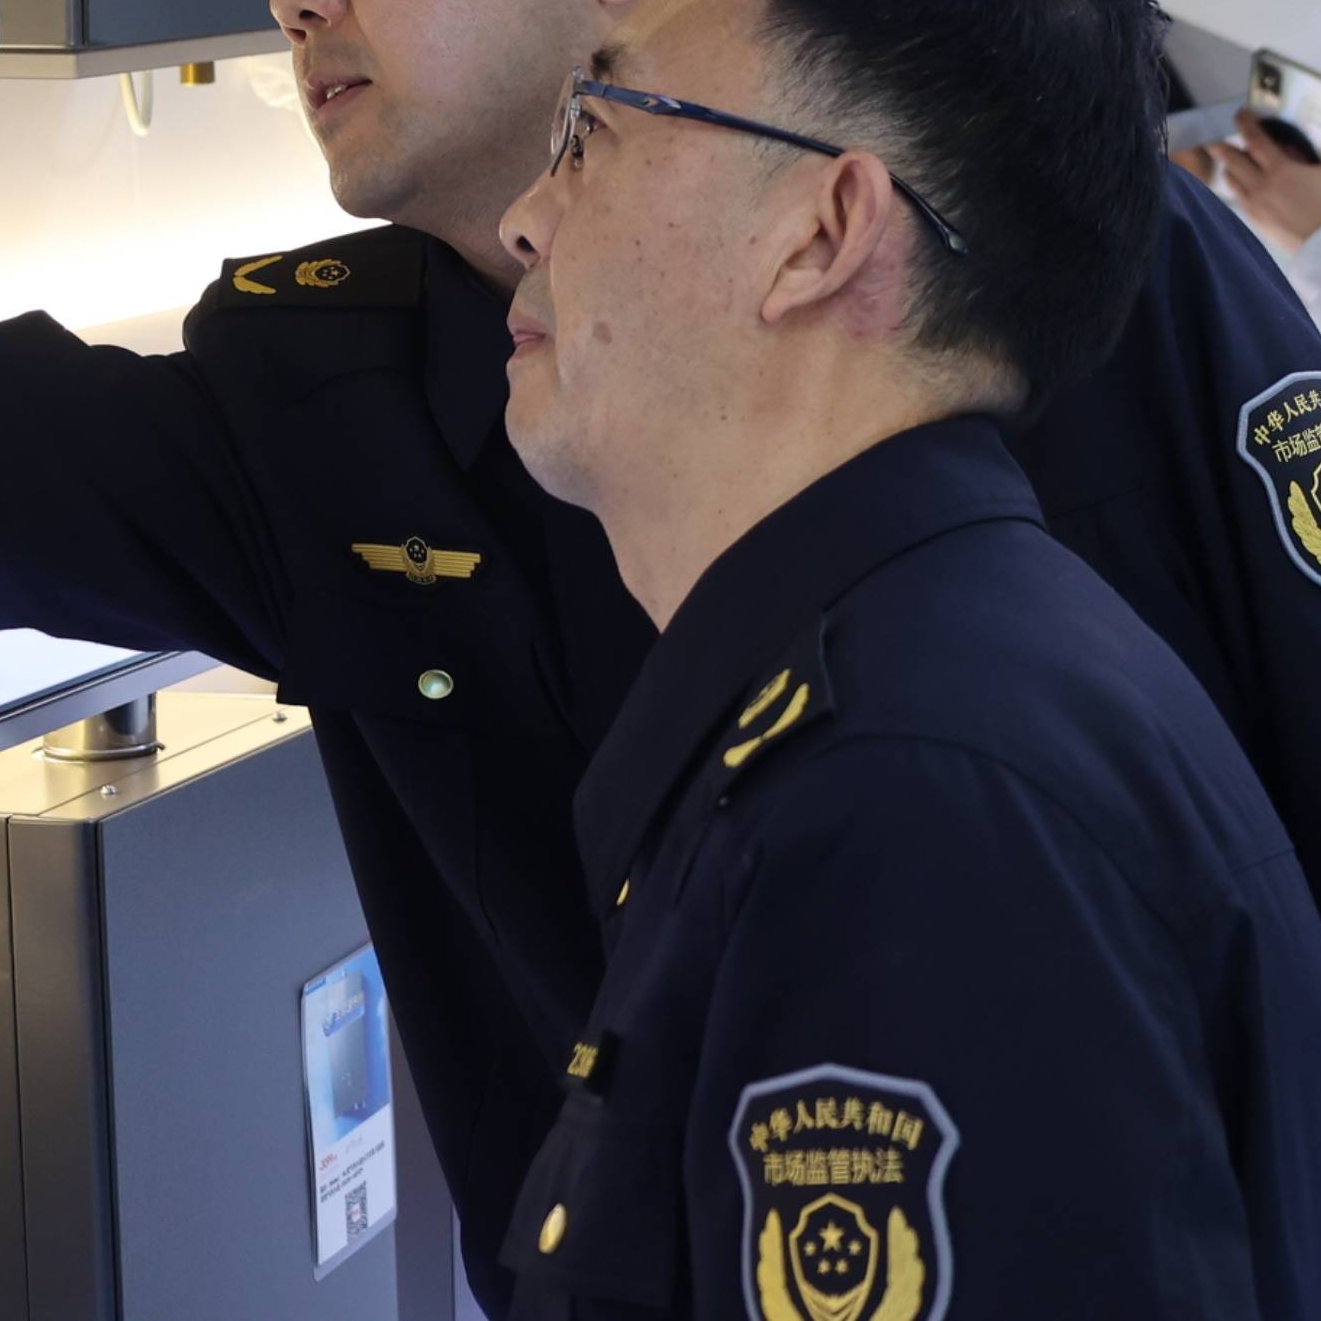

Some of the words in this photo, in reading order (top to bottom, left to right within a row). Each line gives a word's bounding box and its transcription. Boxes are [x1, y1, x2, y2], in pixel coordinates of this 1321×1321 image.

[748, 1096, 925, 1153] 中华人民共和国
[762, 1145, 905, 1187] 市场监管执法
